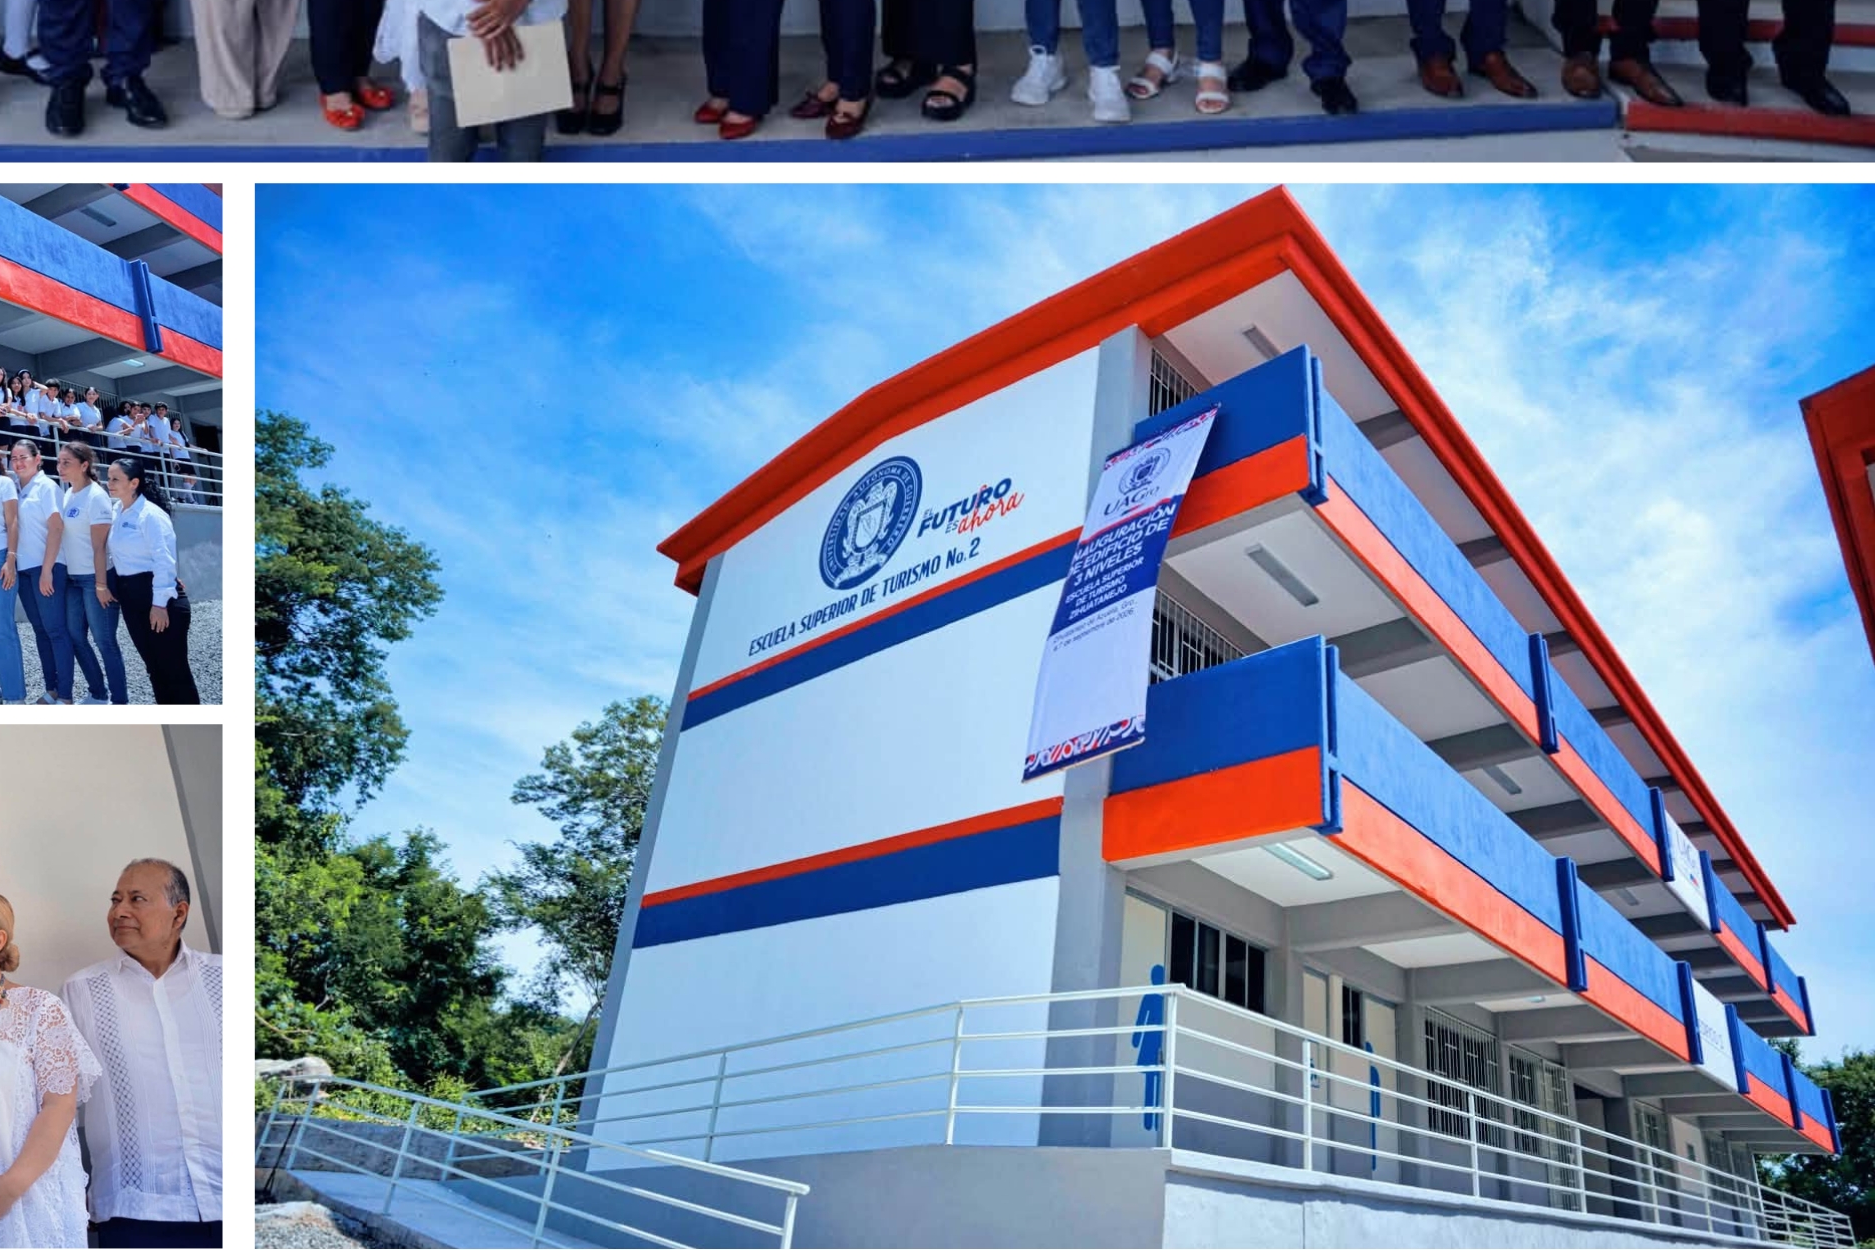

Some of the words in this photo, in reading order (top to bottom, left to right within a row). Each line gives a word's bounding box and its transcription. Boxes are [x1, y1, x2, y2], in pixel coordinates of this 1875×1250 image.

[917, 477, 1012, 538] FUTURO
[957, 491, 1025, 535] ahora
[1074, 573, 1084, 587] 3
[1084, 541, 1143, 581] NIVELES
[1083, 529, 1144, 570] EDIFICIO
[1145, 517, 1170, 537] DE
[748, 622, 796, 657] ESCUELA
[798, 594, 859, 634] SUPERIOR
[860, 584, 880, 607] DE
[882, 554, 941, 598] TURISMO
[946, 547, 967, 569] No.
[968, 536, 981, 559] 2
[1065, 578, 1101, 604] ESCUELA
[1101, 556, 1145, 584] SUPERIOR
[1068, 584, 1128, 620] ZIHUATANEJO
[1087, 575, 1126, 600] TURISMO
